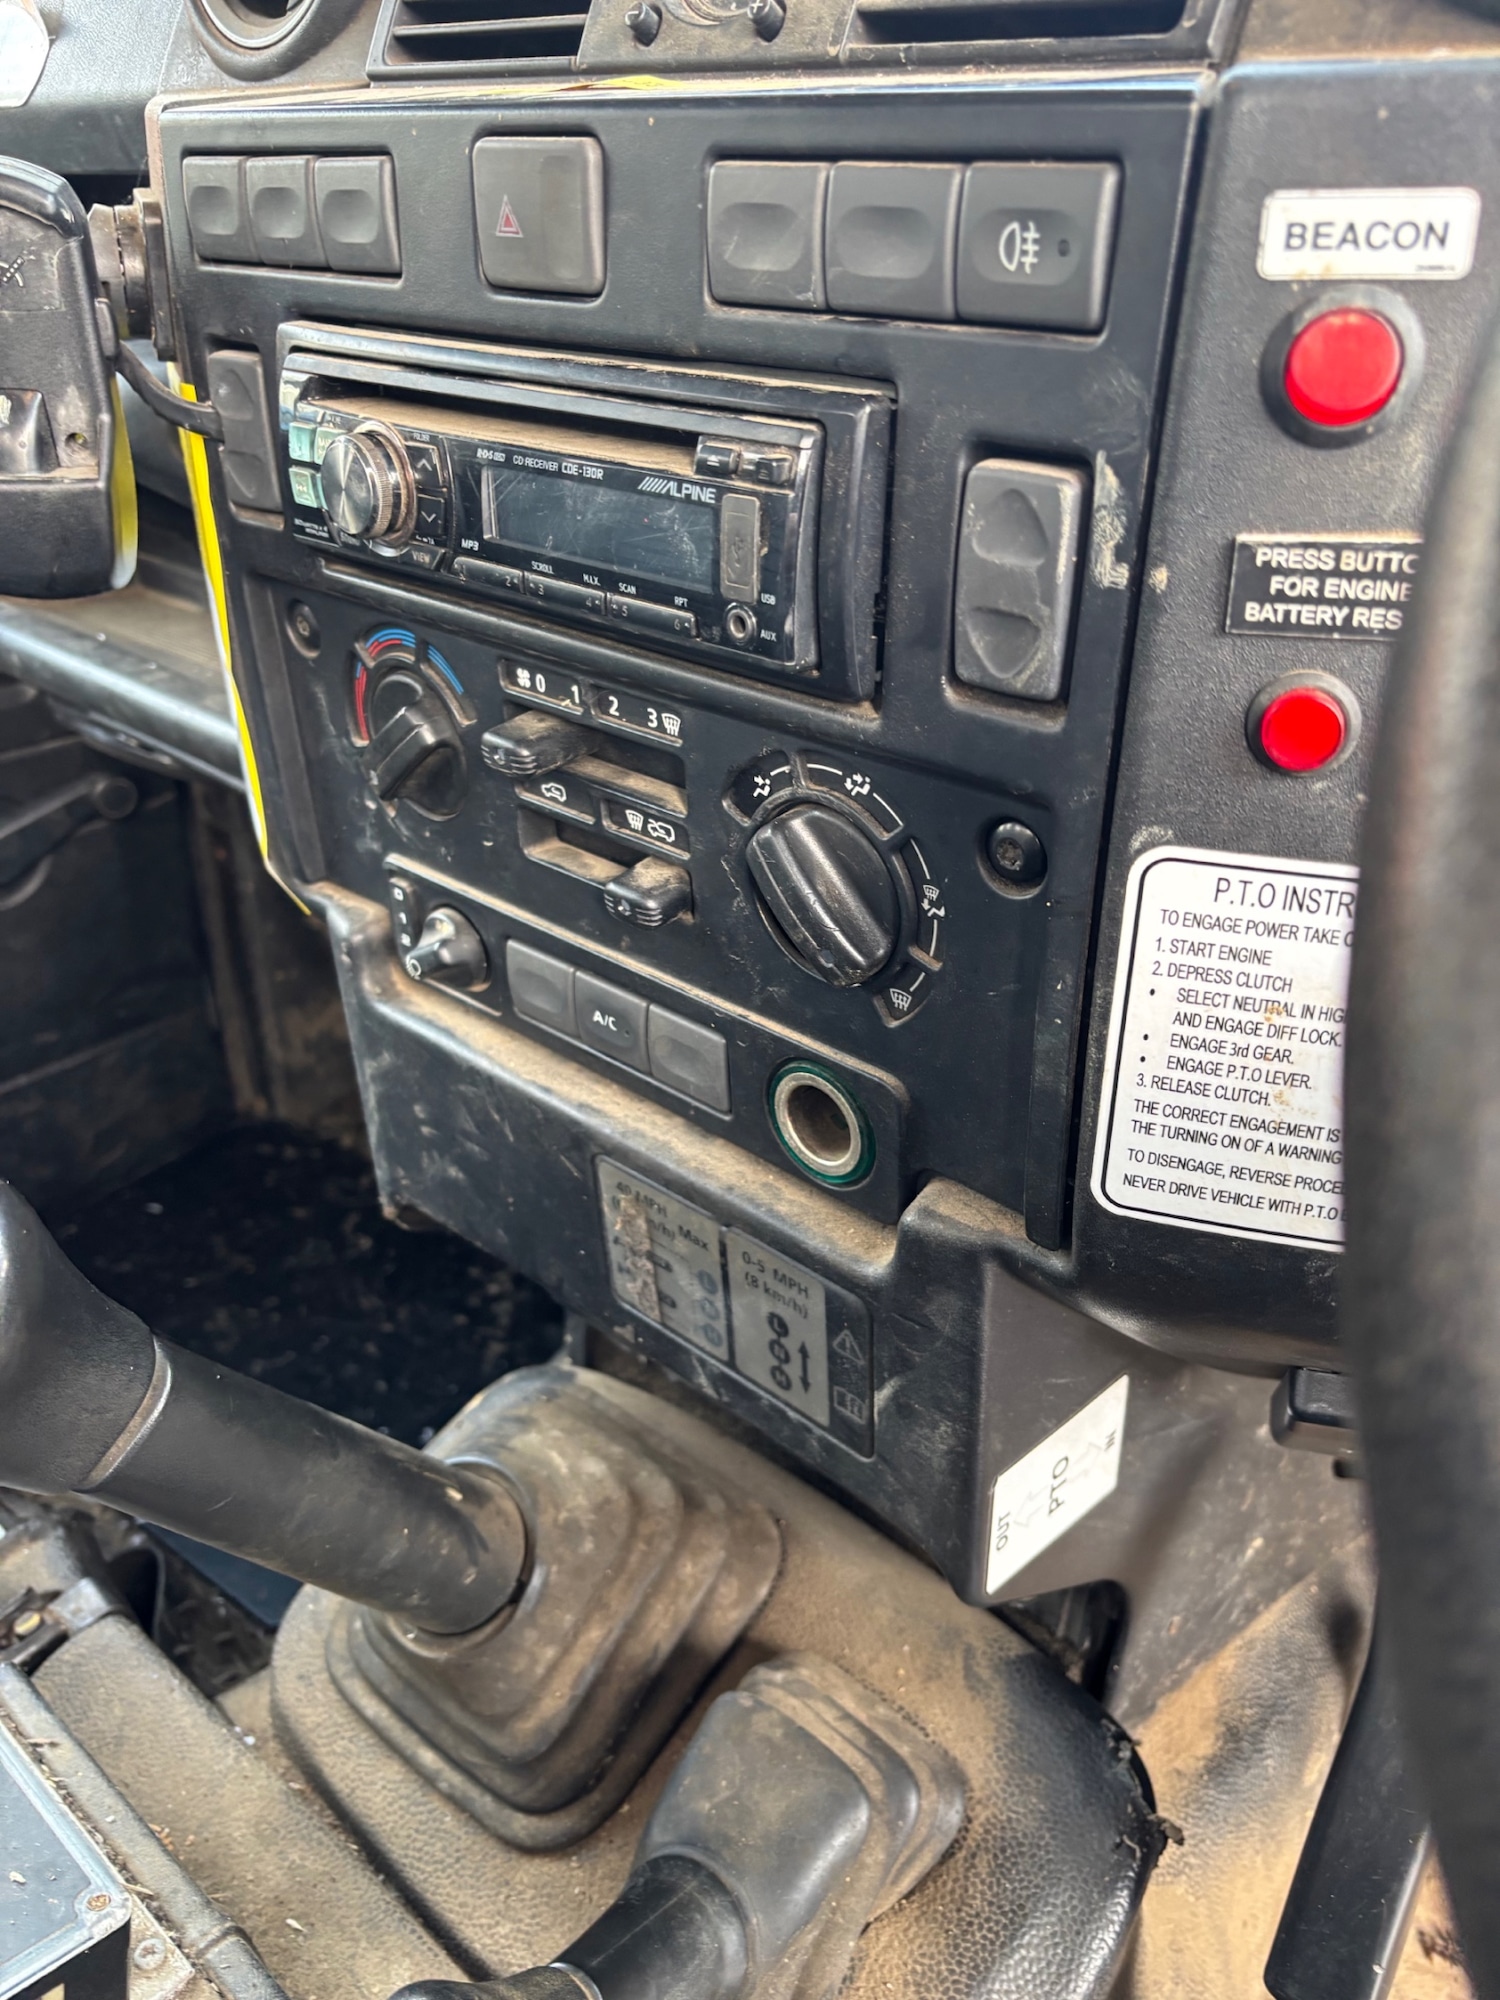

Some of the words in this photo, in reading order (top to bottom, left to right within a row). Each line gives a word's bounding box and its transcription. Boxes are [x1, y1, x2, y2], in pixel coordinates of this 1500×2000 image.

[1284, 220, 1450, 251] BEACON
[512, 455, 524, 466] CD
[524, 457, 558, 472] RECEIVER
[562, 462, 604, 480] CDE-130R
[638, 476, 716, 504] ALPINE
[461, 538, 480, 552] MP3
[1255, 547, 1336, 571] PRESS
[531, 560, 555, 574] SCROLL
[538, 584, 544, 596] 3
[618, 582, 636, 595] SCAN
[674, 596, 688, 608] RPT
[760, 593, 776, 606] USB
[1270, 575, 1320, 598] FOR
[1324, 577, 1413, 602] ENGINE
[622, 605, 628, 617] 5
[674, 619, 680, 630] 6
[1244, 601, 1349, 627] BATTERY
[1352, 606, 1404, 630] RES
[760, 630, 777, 642] AUX
[571, 685, 580, 704] 1
[608, 696, 620, 716] 2
[647, 708, 658, 728] 3
[1214, 877, 1276, 908] P.T.O
[1282, 885, 1356, 918] INSTR
[1160, 908, 1180, 926] TO
[1182, 912, 1243, 934] ENGAGE
[1245, 920, 1300, 941] POWER
[1304, 926, 1341, 946] TAKE
[1156, 937, 1166, 952] 1.
[1170, 938, 1216, 958] START
[1218, 945, 1272, 966] ENGINE
[1152, 960, 1163, 976] 2.
[1167, 962, 1232, 984] DEPRESS
[1236, 972, 1293, 993] CLUTCH
[592, 1010, 618, 1032] A/C
[1176, 988, 1231, 1008] SELECT
[1232, 995, 1296, 1018] NEUTRAL
[1300, 1004, 1316, 1020] IN
[1318, 1006, 1346, 1024] HIG
[1172, 1011, 1202, 1028] AND
[1205, 1015, 1264, 1037] ENGAGE
[1266, 1024, 1298, 1041] DIFF
[1300, 1028, 1342, 1048] LOCK.
[1170, 1034, 1228, 1055] ENGAGE
[1229, 1042, 1250, 1058] 3rd
[1253, 1045, 1294, 1065] GEAR.
[1167, 1056, 1224, 1077] ENGAGE
[1226, 1064, 1262, 1082] P.T.O
[1264, 1069, 1312, 1090] LEVER.
[1136, 1073, 1146, 1088] 3.
[1151, 1075, 1212, 1098] RELEASE
[1214, 1085, 1271, 1107] CLUTCH.
[1134, 1098, 1160, 1116] THE
[1162, 1104, 1228, 1126] CORRECT
[1230, 1114, 1325, 1140] ENGAGEMENT
[1326, 1128, 1341, 1143] IS
[1131, 1119, 1157, 1136] THE
[1160, 1124, 1218, 1146] TURNING
[1221, 1134, 1241, 1150] ON
[1244, 1138, 1264, 1152] OF
[1264, 1142, 1274, 1156] A
[1278, 1142, 1342, 1164] WARNING
[1128, 1148, 1144, 1162] TO
[1147, 1152, 1225, 1179] DISENGAGE,
[1229, 1166, 1292, 1187] REVERSE
[1123, 1173, 1166, 1192] NEVER
[1168, 1182, 1208, 1200] DRIVE
[1211, 1188, 1266, 1210] VEHICLE
[1268, 1198, 1302, 1216] WITH
[1303, 1204, 1339, 1220] P.T.O
[678, 1225, 709, 1251] Max
[742, 1251, 766, 1274] 0-5
[773, 1268, 808, 1298] MPH
[763, 1281, 808, 1319] km/h)
[1048, 1456, 1070, 1516] PTO
[996, 1512, 1011, 1552] OUT
